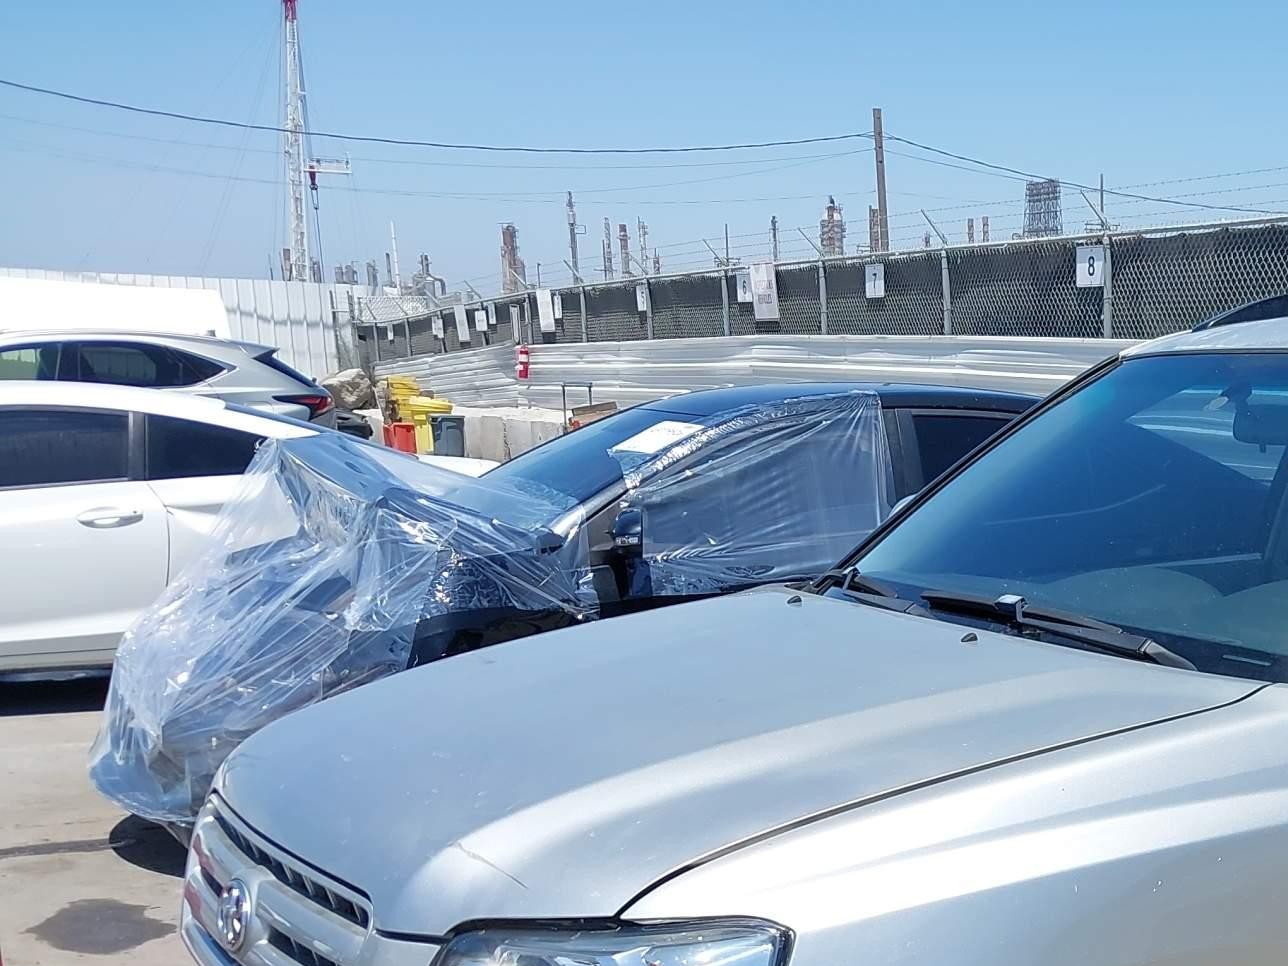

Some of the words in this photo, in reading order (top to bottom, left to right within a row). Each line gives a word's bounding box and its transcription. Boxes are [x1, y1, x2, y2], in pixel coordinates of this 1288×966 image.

[1088, 256, 1095, 277] 8
[742, 280, 747, 295] 6
[872, 272, 877, 289] 7
